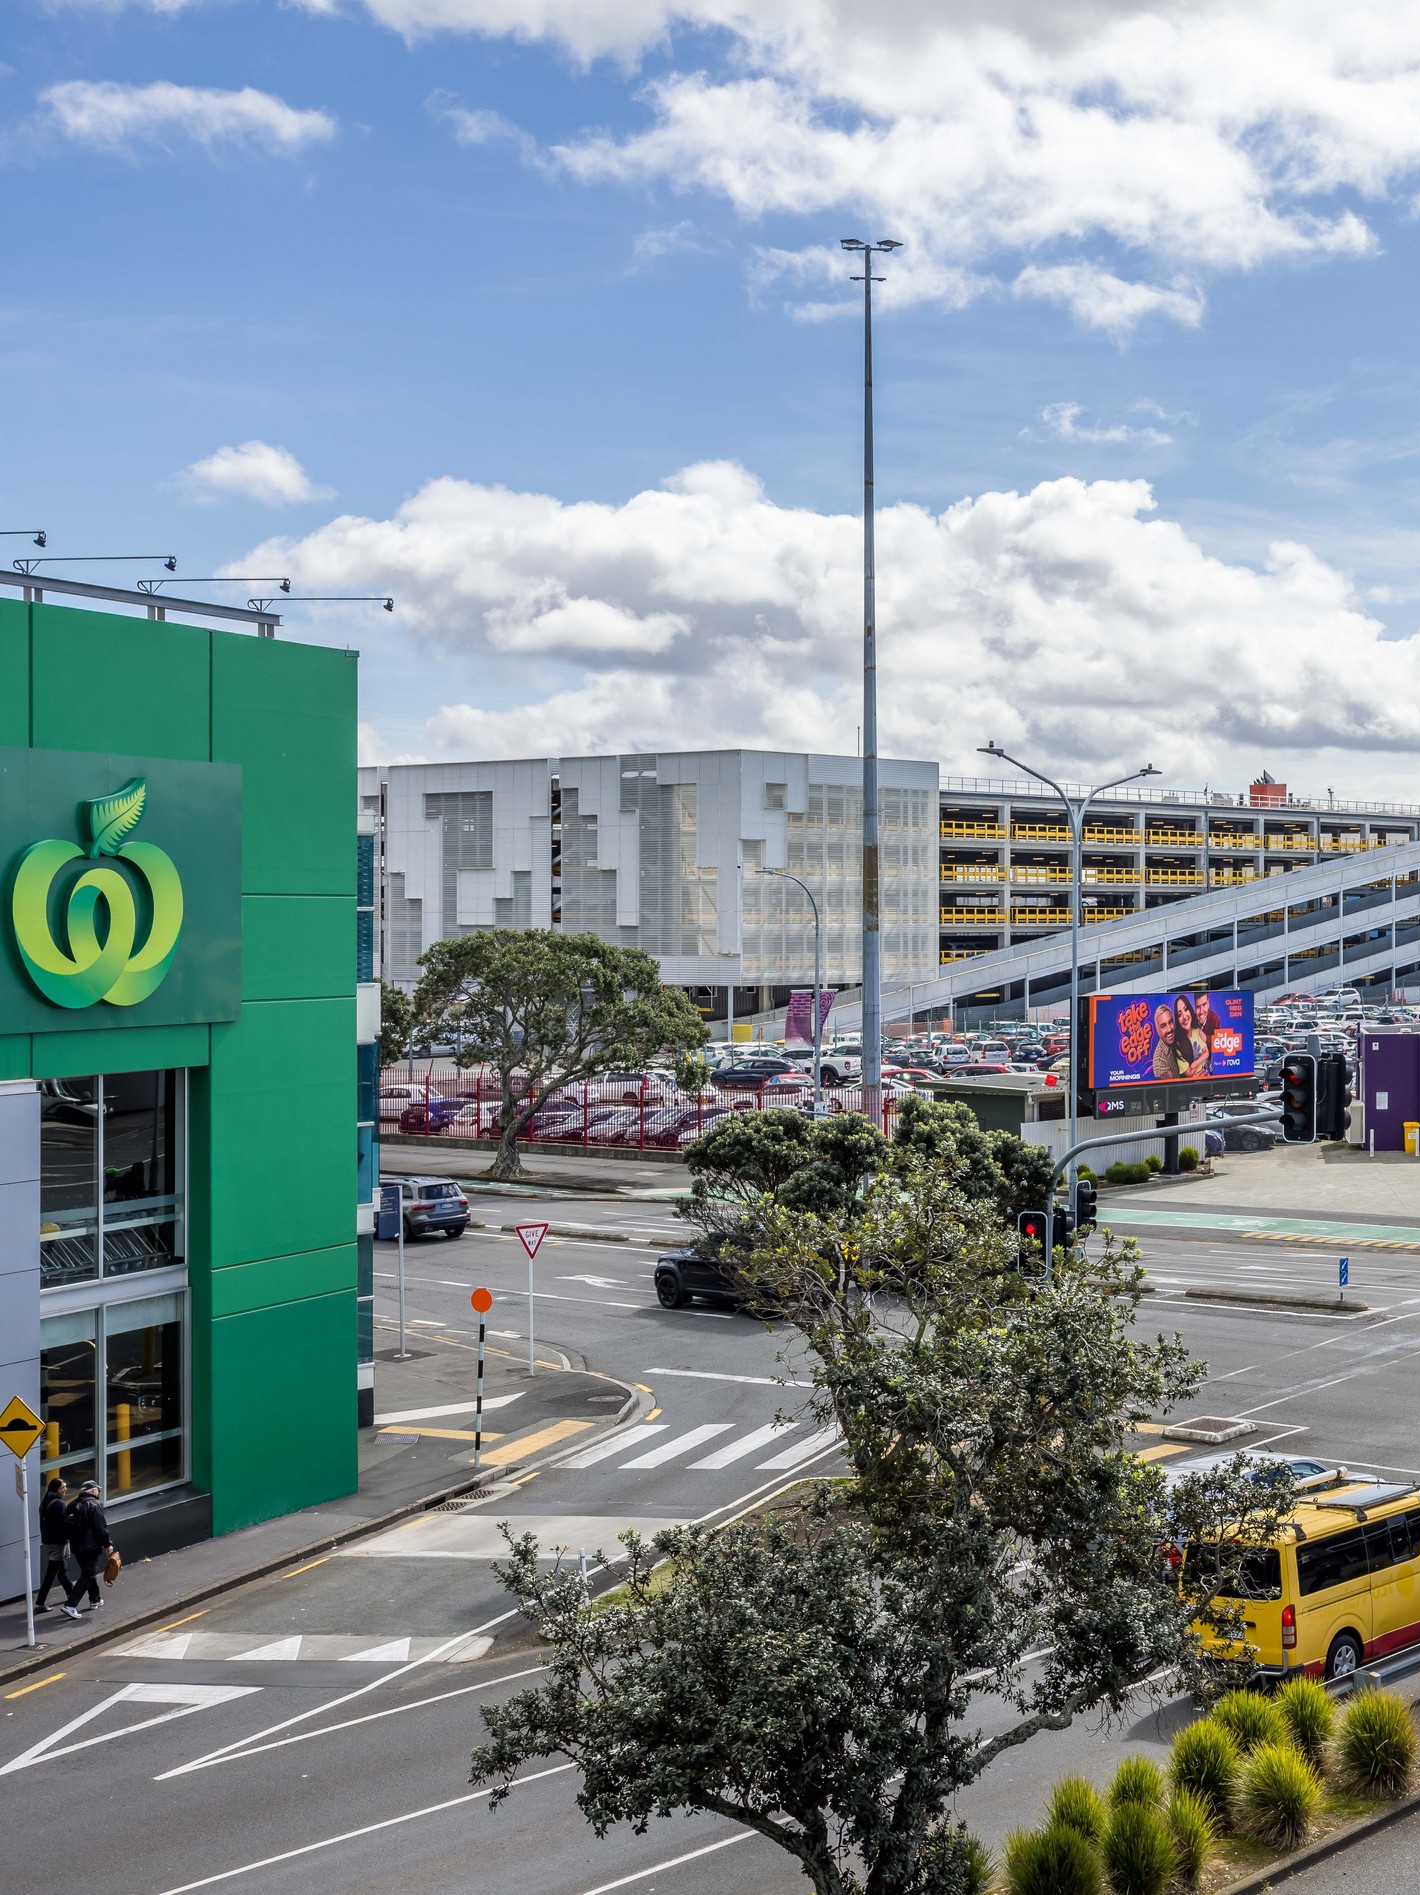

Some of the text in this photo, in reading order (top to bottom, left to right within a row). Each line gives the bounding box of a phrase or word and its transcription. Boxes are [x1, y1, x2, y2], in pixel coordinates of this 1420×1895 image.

[1118, 1002, 1148, 1033] take
[1121, 1023, 1152, 1053] edge
[1213, 1032, 1240, 1053] edge
[1226, 1058, 1241, 1066] rova
[1109, 1073, 1141, 1082] MORNINGS
[1106, 1100, 1125, 1111] QMS
[525, 1230, 539, 1238] GIVE
